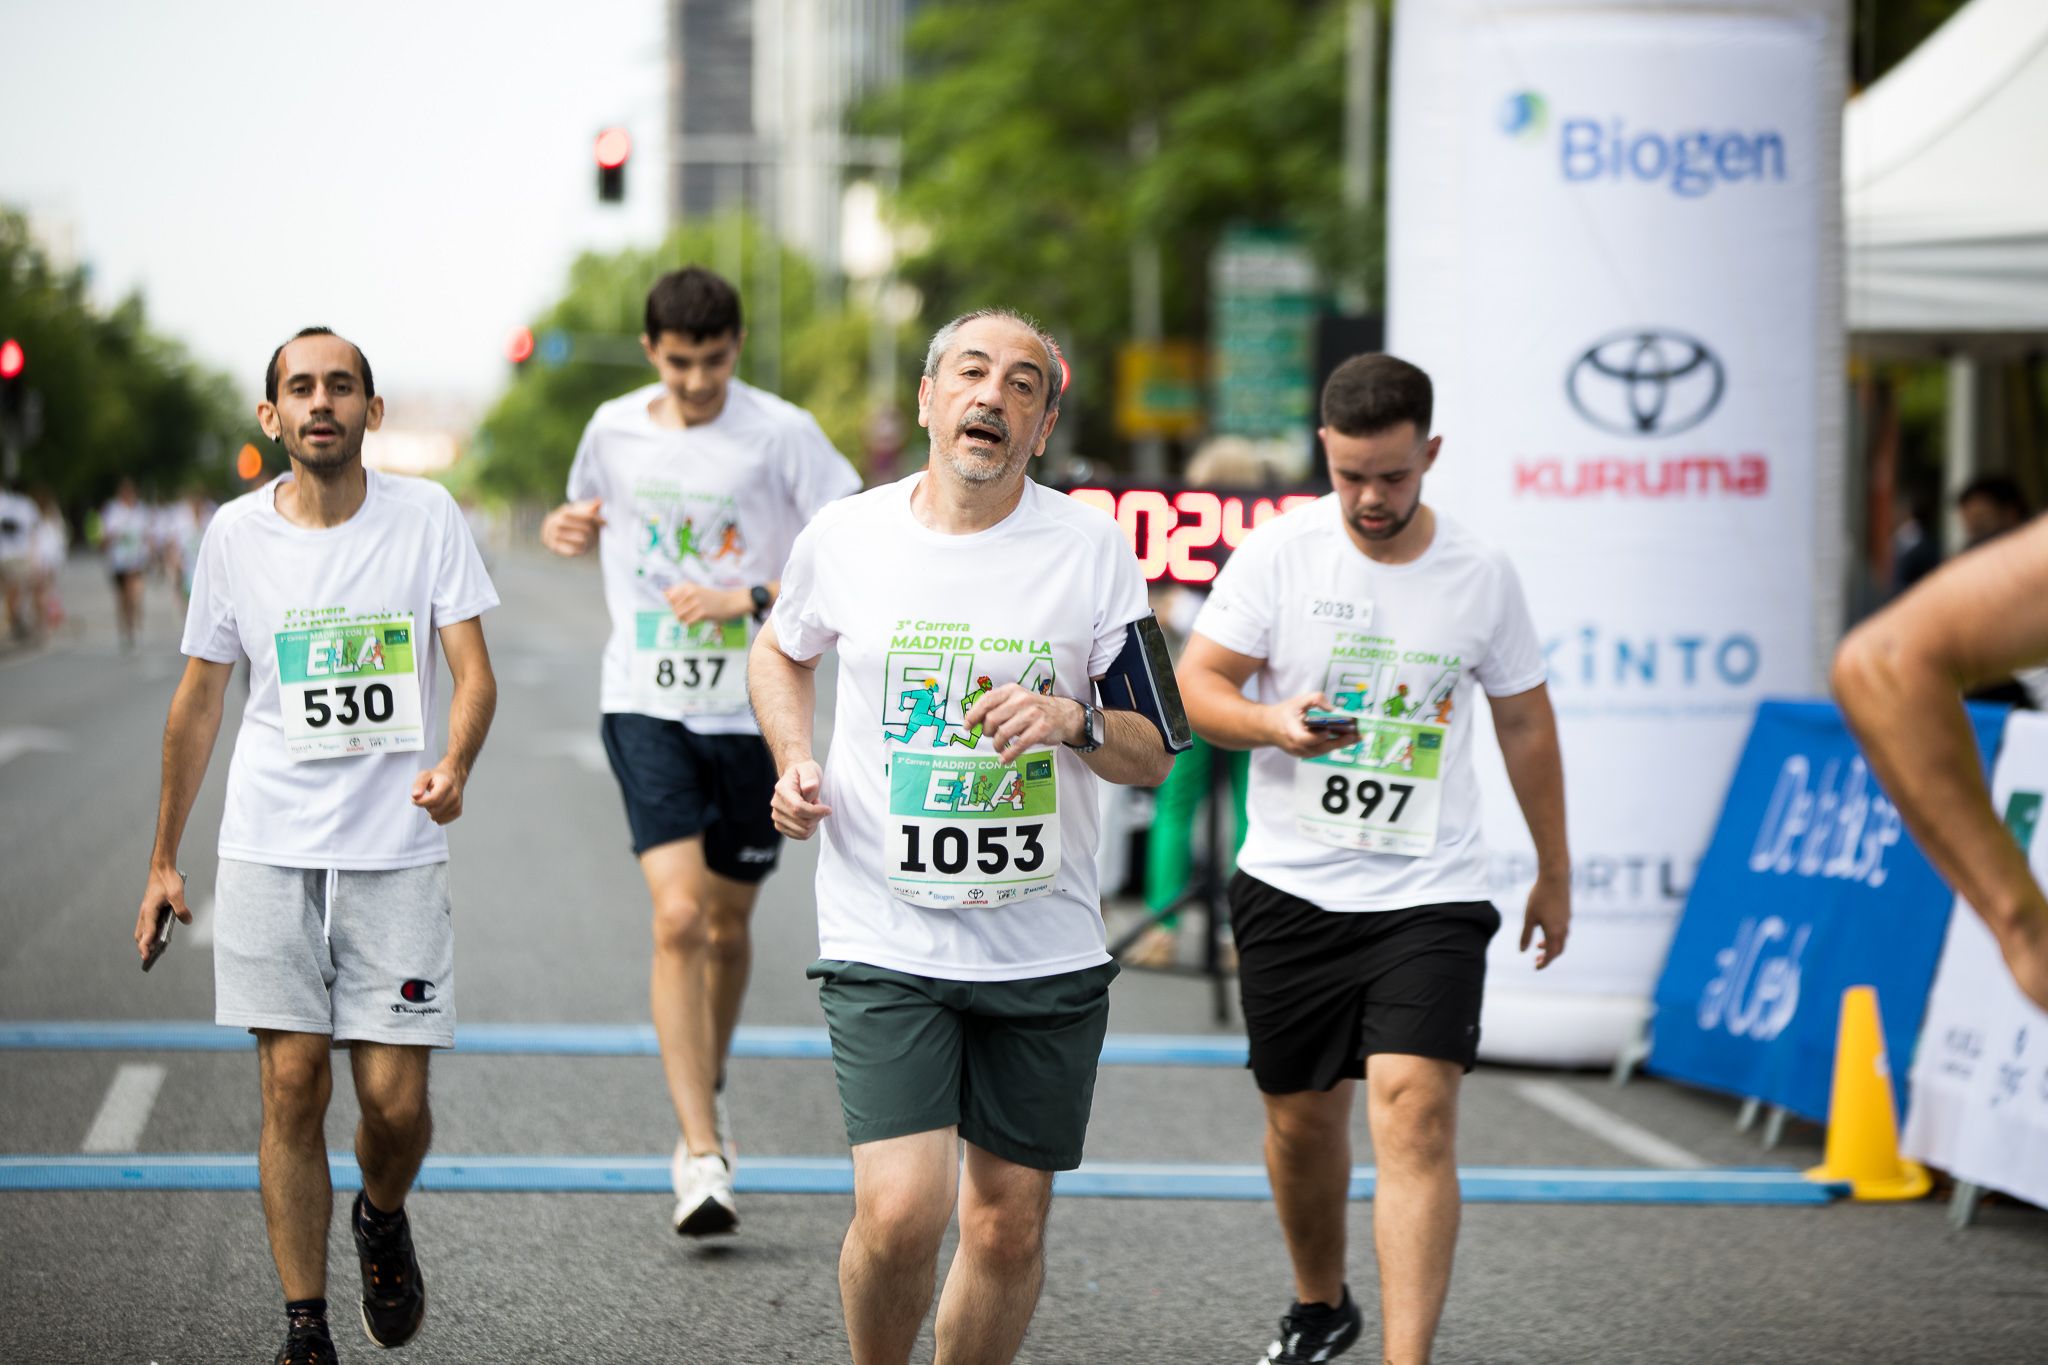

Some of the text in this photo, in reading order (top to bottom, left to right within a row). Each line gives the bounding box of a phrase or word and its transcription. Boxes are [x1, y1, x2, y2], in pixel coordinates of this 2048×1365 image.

[1560, 118, 1788, 199] Biogen
[891, 635, 1051, 654] MADRID CON LA
[915, 621, 970, 632] Carrera
[306, 637, 385, 677] ELA
[656, 658, 726, 688] 837
[1331, 646, 1461, 667] MADRID CON LA
[304, 683, 394, 728] 530
[905, 758, 930, 766] Carrera
[932, 759, 976, 770] MADRID
[978, 761, 1001, 770] CON
[922, 770, 1024, 812] ELA
[1321, 775, 1416, 823] 897
[900, 823, 1045, 875] 1053
